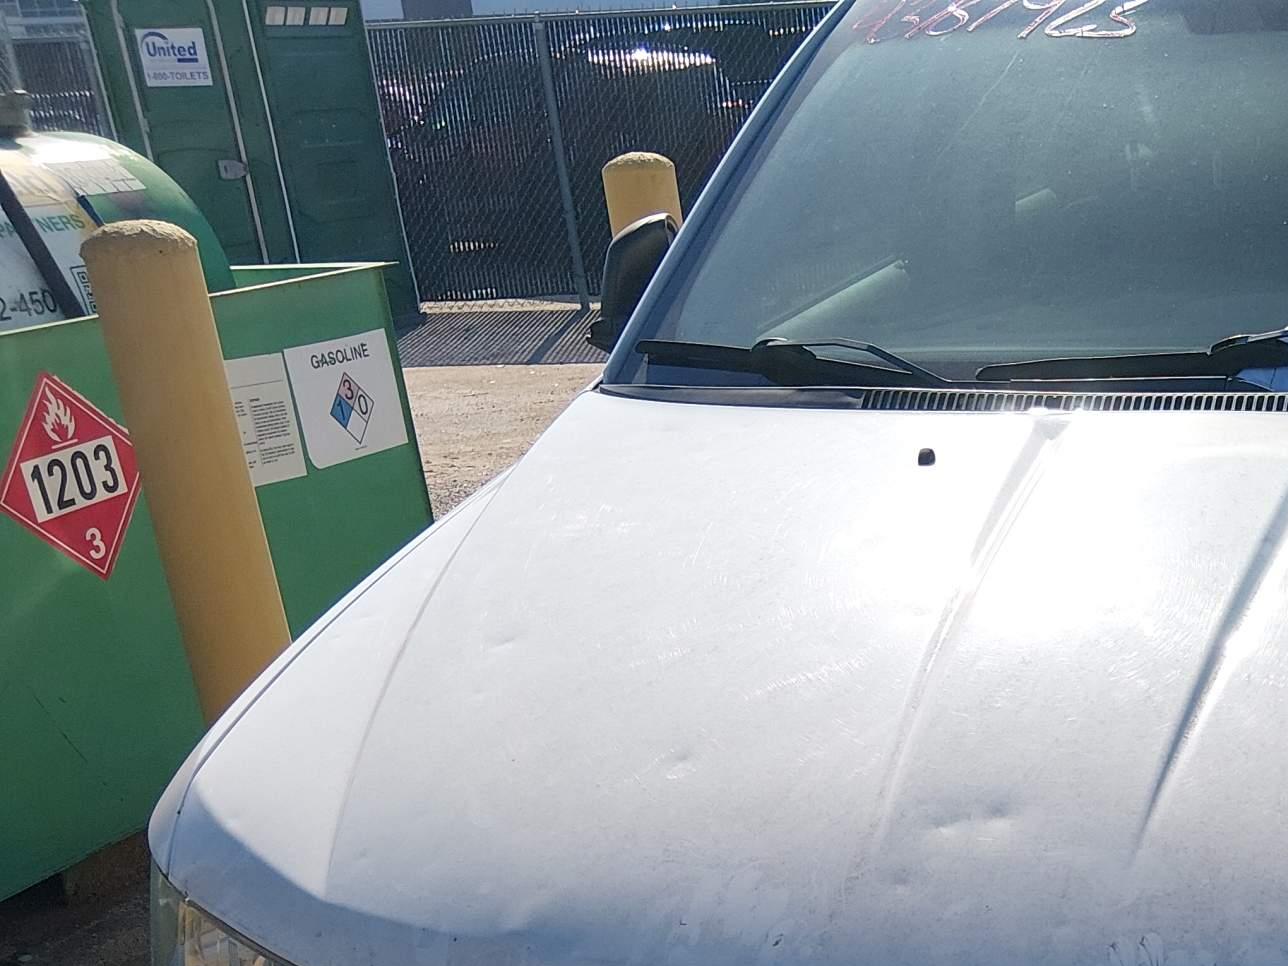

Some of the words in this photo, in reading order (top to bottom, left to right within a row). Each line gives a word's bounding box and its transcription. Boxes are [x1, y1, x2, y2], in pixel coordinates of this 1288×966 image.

[145, 41, 198, 57] United
[146, 71, 209, 81] 1-800-TOILETS
[310, 343, 370, 370] GASOLINE
[342, 379, 355, 401] 3
[336, 401, 347, 422] 1
[357, 394, 369, 416] 0
[31, 443, 119, 515] 1203
[85, 527, 106, 560] 3
